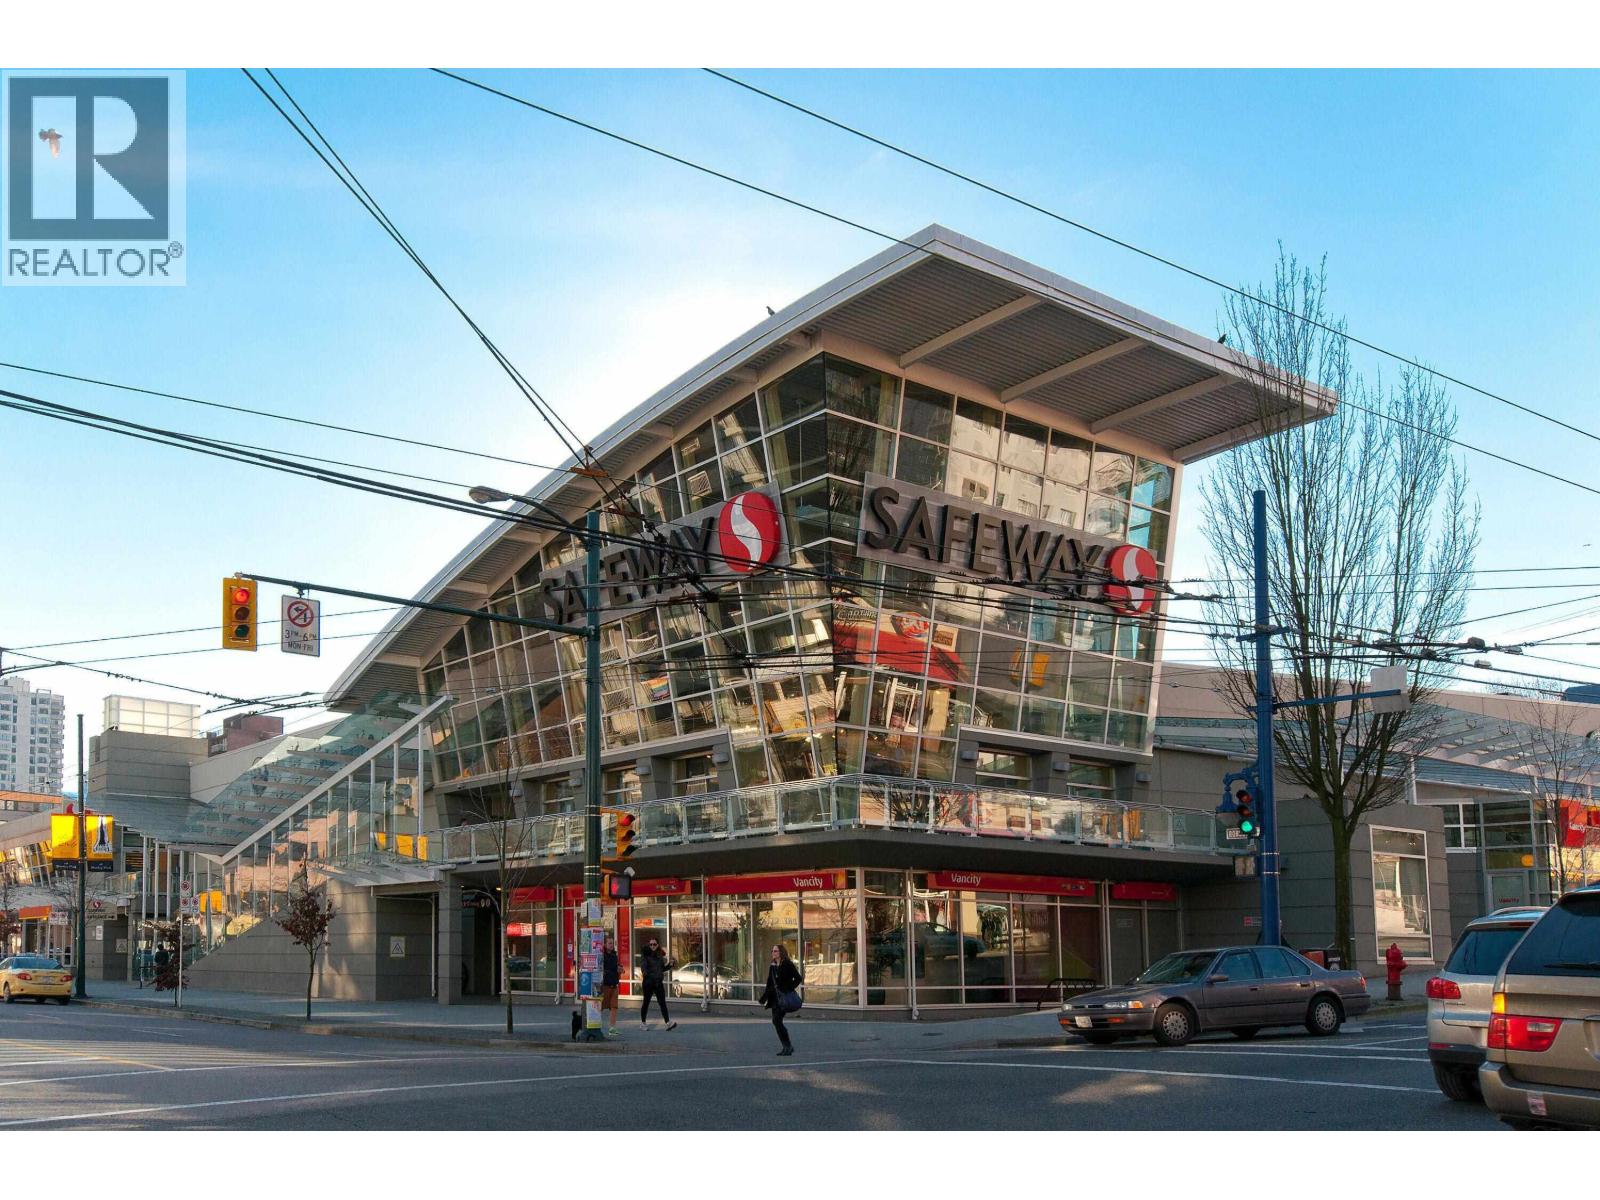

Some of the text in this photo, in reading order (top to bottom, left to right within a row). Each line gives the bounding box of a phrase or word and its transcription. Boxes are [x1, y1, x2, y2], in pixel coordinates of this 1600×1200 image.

[863, 486, 1105, 598] SAFEWAY
[540, 516, 715, 624] SAEWAY
[287, 641, 314, 652] MON-FRI
[793, 876, 823, 888] Vancity
[951, 872, 981, 887] Vancity
